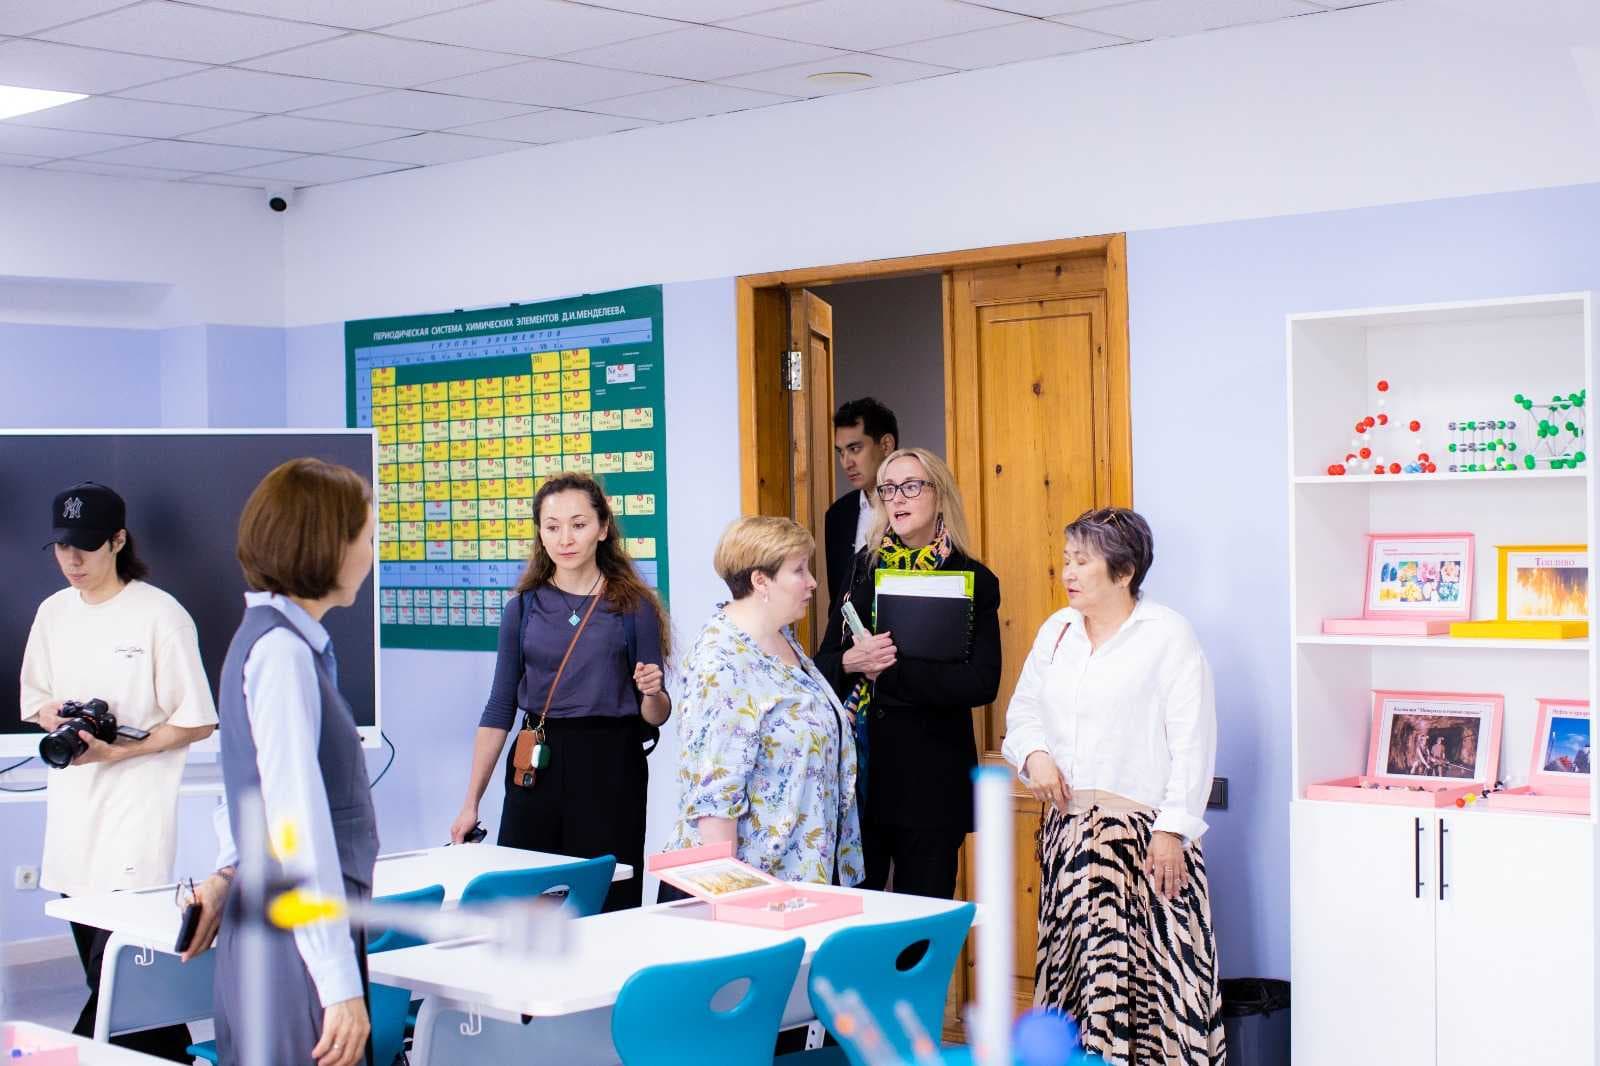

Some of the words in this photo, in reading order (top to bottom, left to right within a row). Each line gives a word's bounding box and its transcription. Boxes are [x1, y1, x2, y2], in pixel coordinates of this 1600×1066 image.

[373, 327, 429, 341] ПЕРИОДИЧЕСКАЯ
[431, 324, 463, 335] СИСТЕМА
[465, 317, 514, 332] ХИМИЧЕСКИХ
[516, 313, 559, 326] ЭЛЕМЕНТОВ
[562, 305, 626, 322] Д.И.МЕНДЕЛЕЕВА
